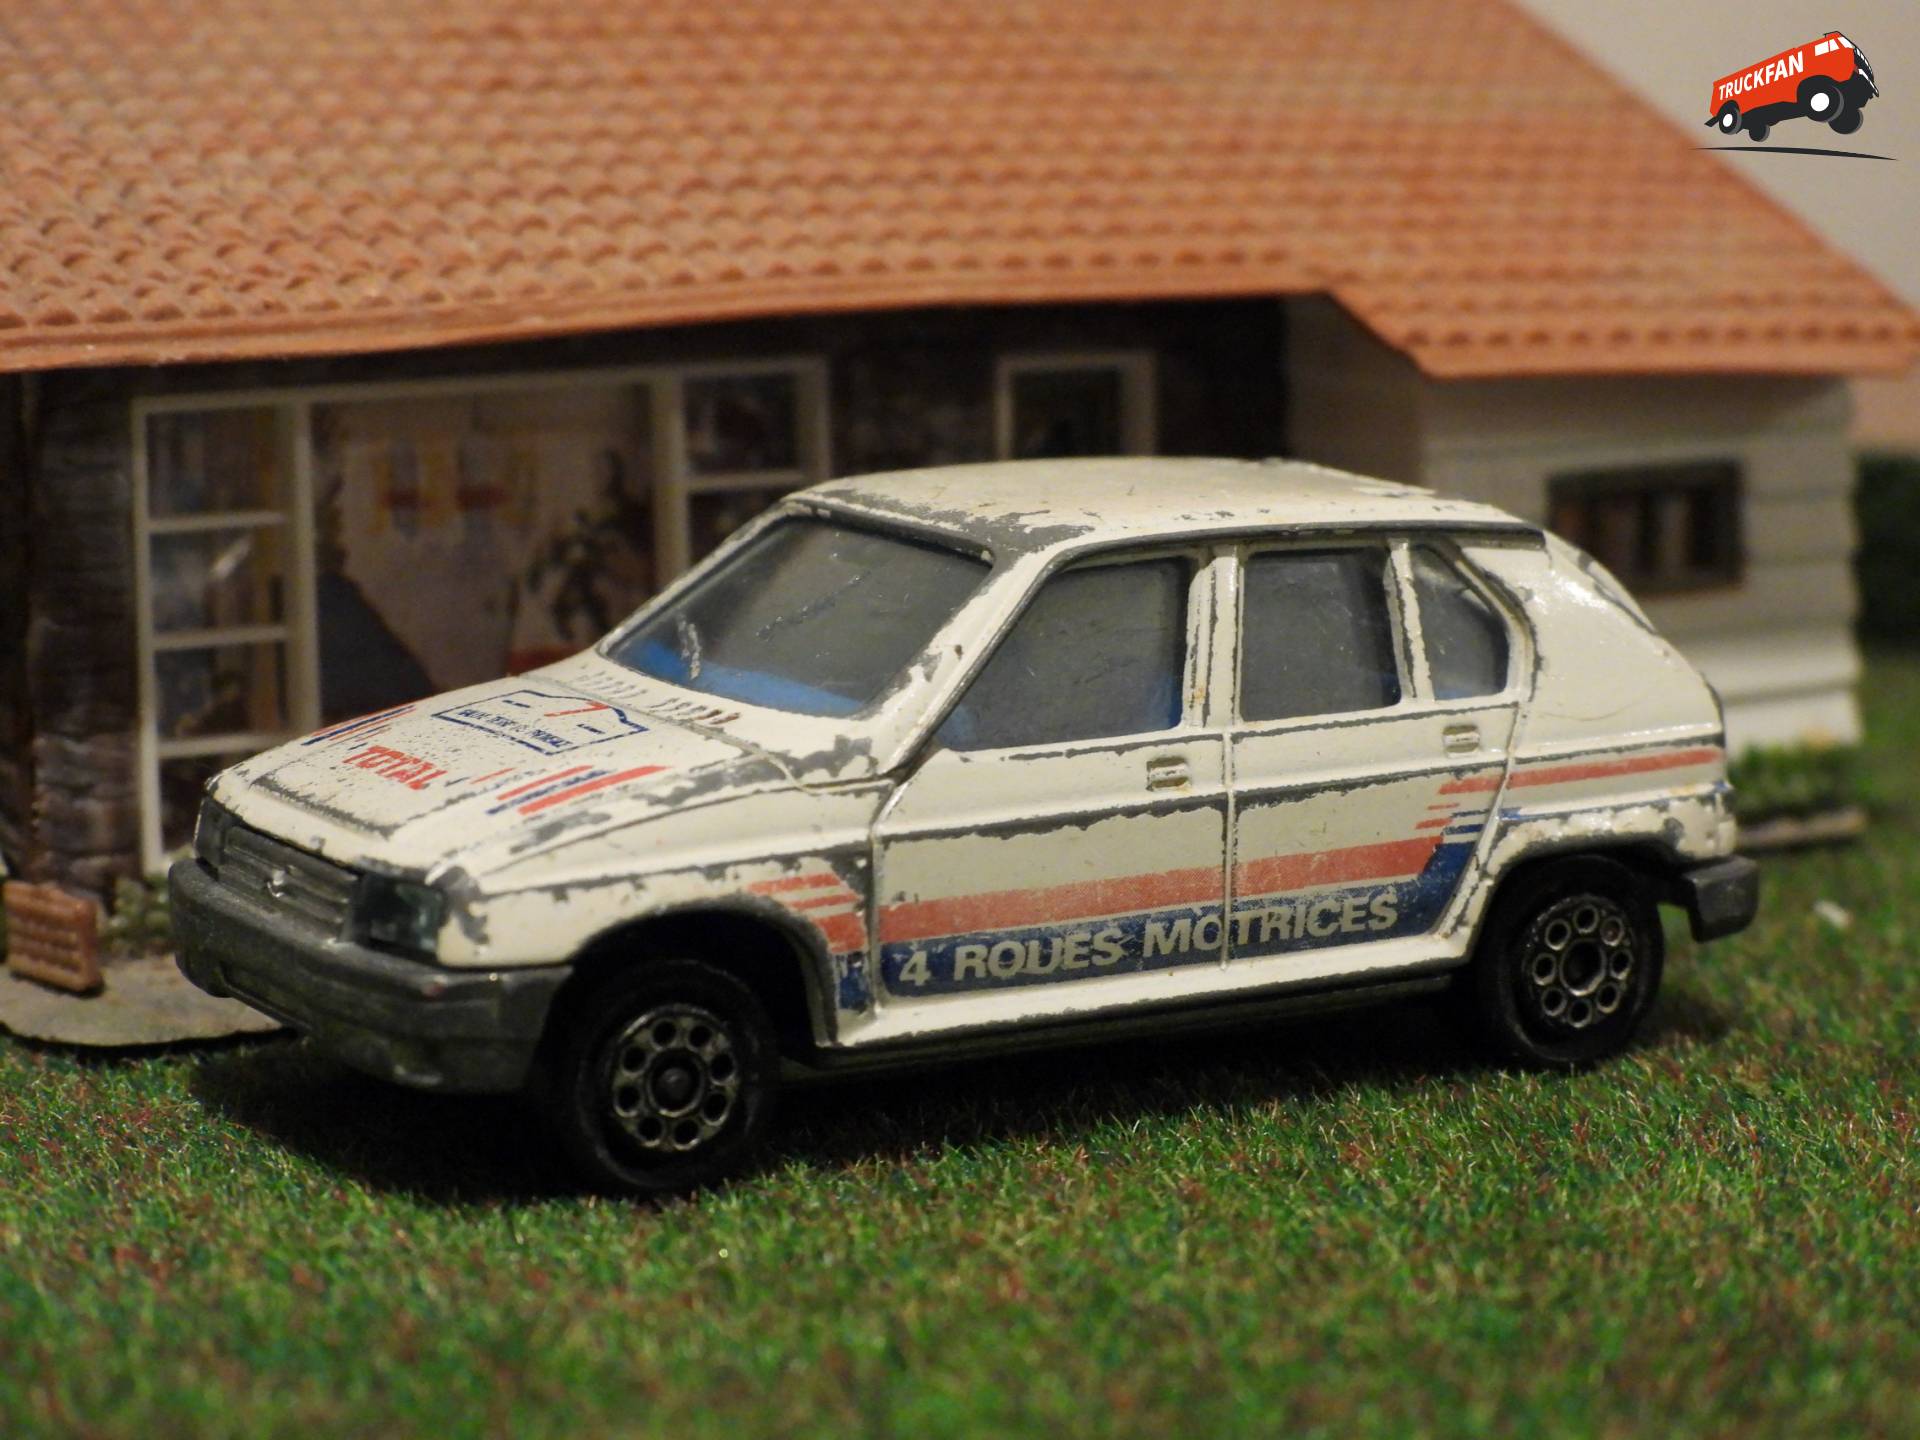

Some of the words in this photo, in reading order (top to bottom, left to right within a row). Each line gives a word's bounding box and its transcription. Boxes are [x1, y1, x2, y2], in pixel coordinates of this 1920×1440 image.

[342, 745, 447, 791] TOTAL
[898, 949, 931, 987] 4
[953, 935, 1122, 981] ROUES
[1142, 896, 1398, 958] MOTRICES
